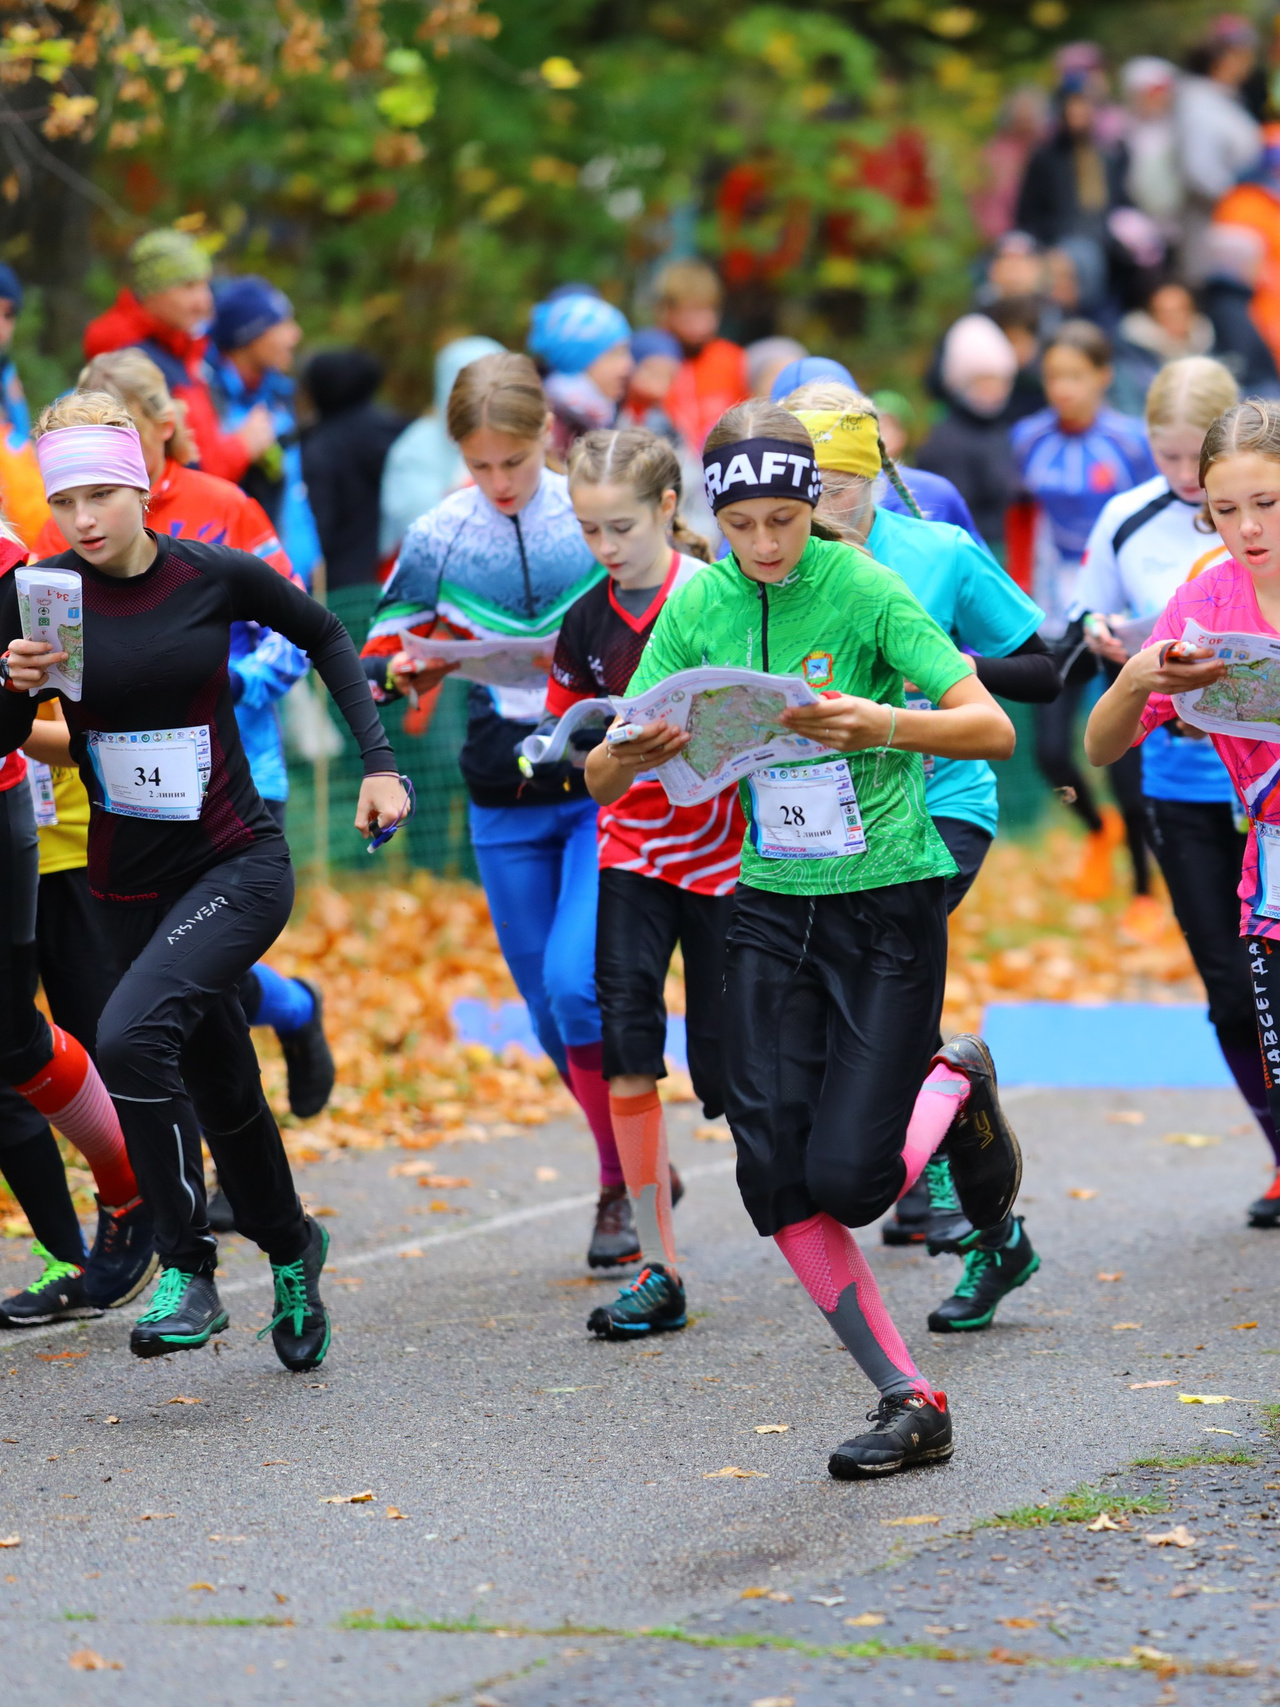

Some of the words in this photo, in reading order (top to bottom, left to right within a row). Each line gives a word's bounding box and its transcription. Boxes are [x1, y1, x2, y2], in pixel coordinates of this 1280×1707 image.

[47, 589, 70, 602] 34.1
[134, 766, 161, 787] 34
[149, 790, 154, 798] 2
[779, 805, 805, 826] 28
[796, 830, 800, 838] 2
[803, 829, 832, 838] линия
